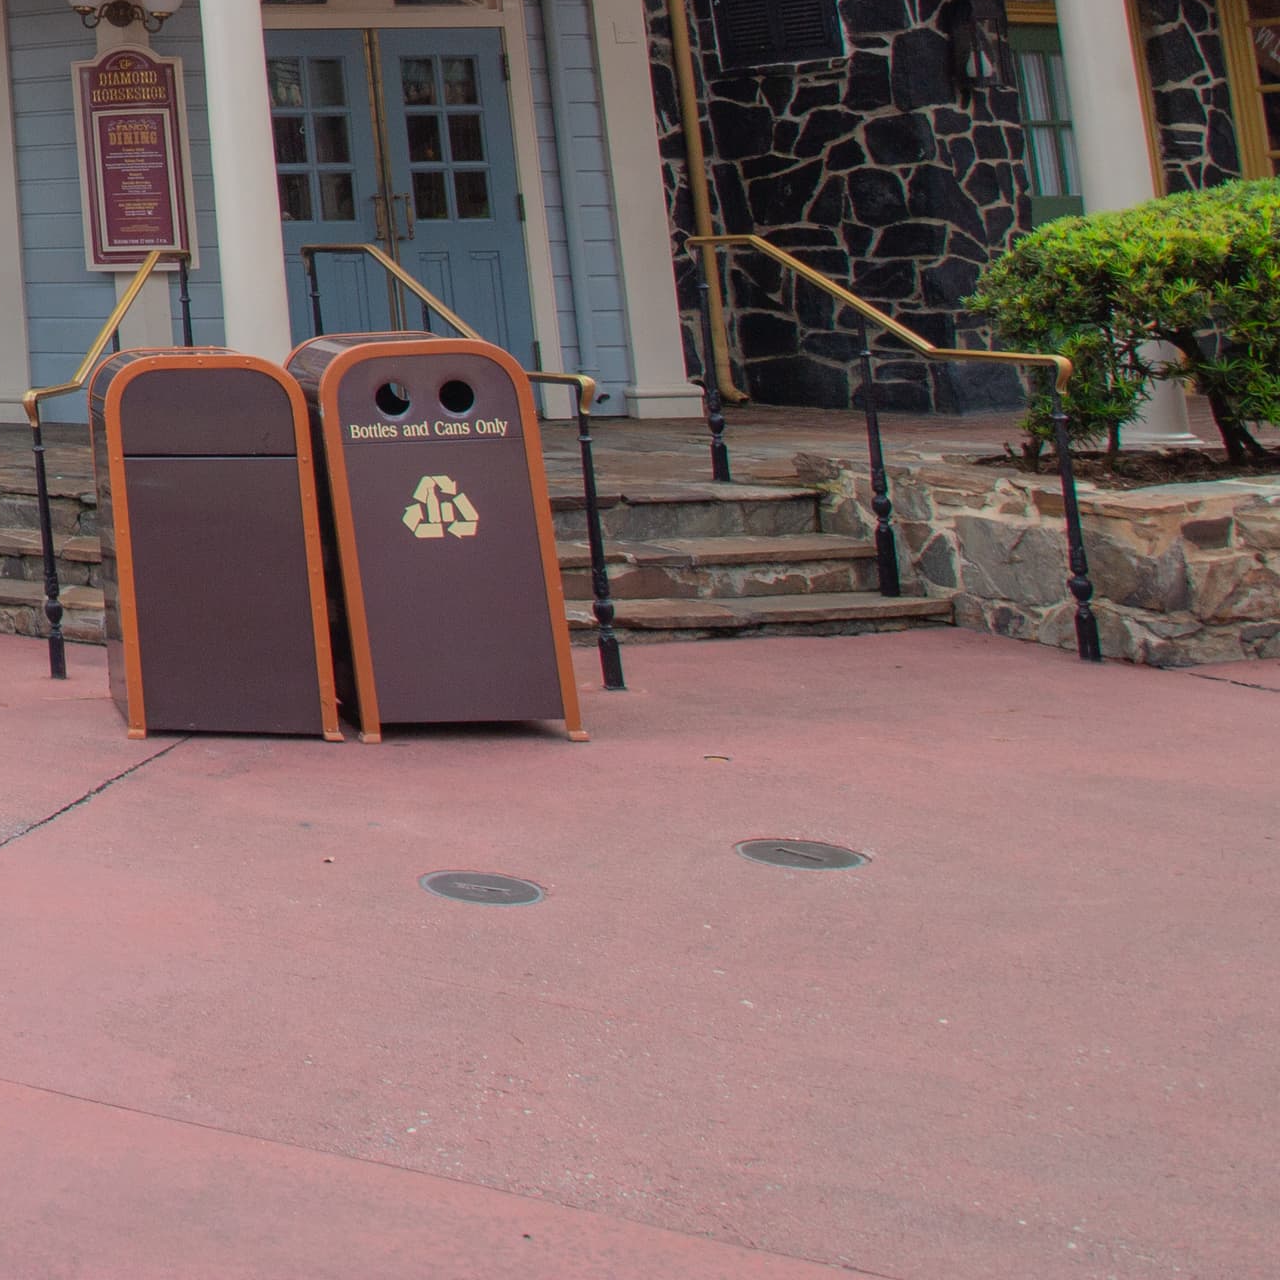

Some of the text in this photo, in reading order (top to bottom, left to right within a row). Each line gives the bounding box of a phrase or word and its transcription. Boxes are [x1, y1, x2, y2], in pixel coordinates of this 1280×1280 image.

[99, 70, 158, 87] DIAMOND
[92, 86, 167, 103] HORSESHOE
[108, 131, 157, 145] DINING
[349, 418, 508, 439] Bottles and Cans Only
